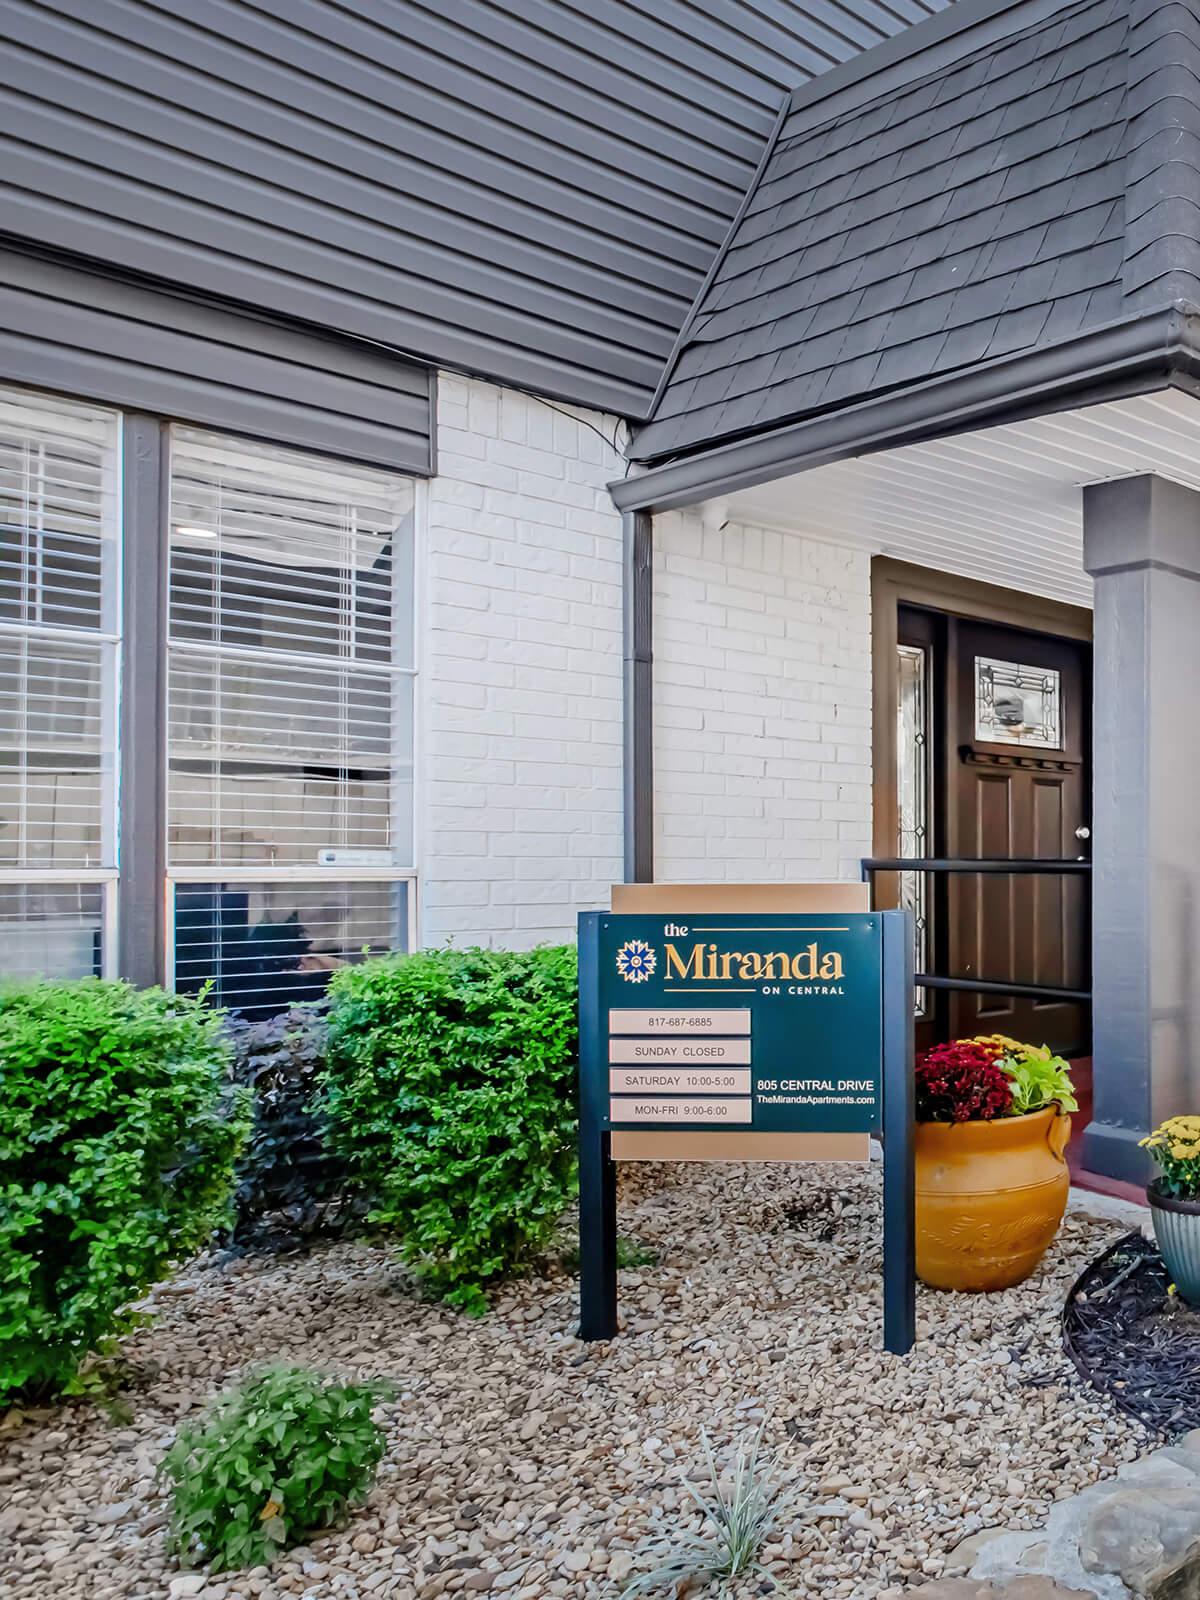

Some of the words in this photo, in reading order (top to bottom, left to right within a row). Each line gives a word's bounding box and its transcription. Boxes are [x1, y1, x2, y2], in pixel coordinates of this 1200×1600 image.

[664, 922, 689, 937] the
[663, 942, 846, 981] Miranda
[762, 986, 780, 995] ON
[788, 986, 844, 995] CENTRAL
[648, 1017, 712, 1027] 817-687-6885
[634, 1047, 677, 1057] SUNDAY
[682, 1047, 725, 1057] CLOSED
[625, 1076, 681, 1086] SATURDAY
[686, 1076, 735, 1086] 10:00-5:00
[757, 1080, 778, 1091] 805
[780, 1080, 835, 1091] CENTRAL
[837, 1080, 875, 1091] DRIVE
[757, 1094, 875, 1105] TheMirandaApartments.com
[634, 1105, 678, 1115] MON-FRI
[683, 1105, 727, 1115] 9:00-6:00
